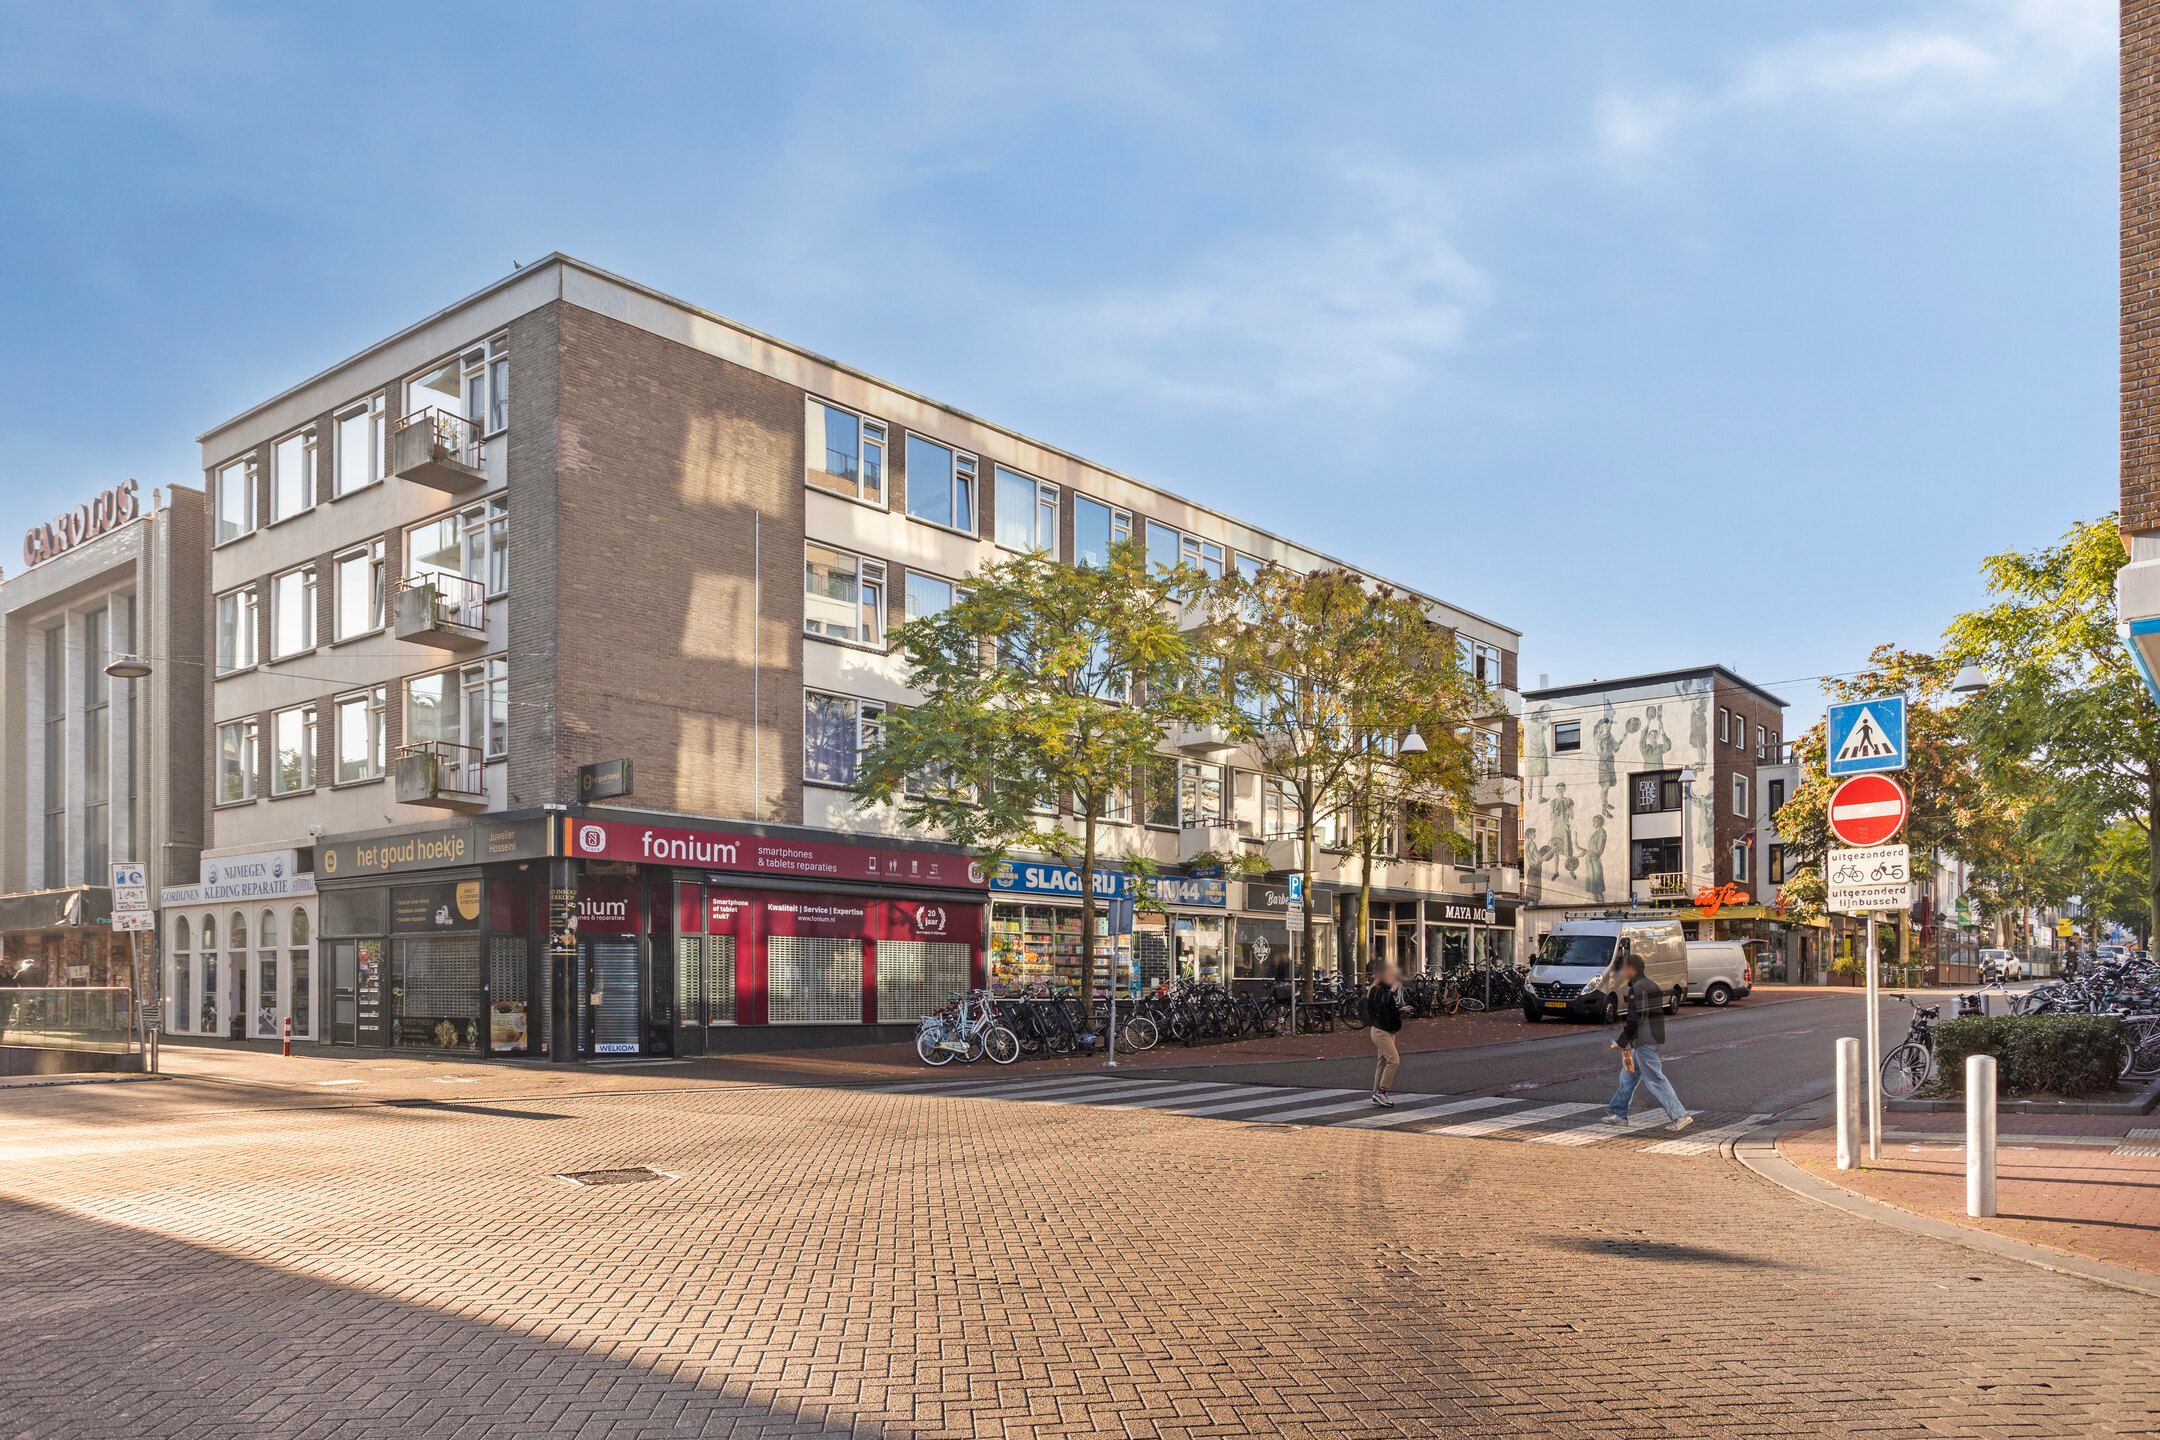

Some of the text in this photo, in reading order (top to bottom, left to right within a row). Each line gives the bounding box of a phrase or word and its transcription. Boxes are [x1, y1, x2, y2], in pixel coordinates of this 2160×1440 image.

[23, 478, 139, 567] CAROLUS
[357, 835, 465, 869] het goud hoekje
[758, 847, 813, 861] smartphones
[1832, 849, 1904, 861] uitgezonderd
[224, 863, 267, 880] NIJMEGEN
[758, 859, 837, 873] & tablets reparaties
[204, 879, 288, 900] KLEDING REPARATIE
[1123, 876, 1178, 899] PEIN
[1180, 882, 1200, 900] 44
[1832, 886, 1906, 898] uitgezonderd
[577, 897, 625, 915] nium
[712, 898, 749, 906] Smartphone
[767, 903, 864, 916] Kwaliteit Service Expertise
[927, 909, 936, 917] 20
[1445, 905, 1471, 919] MAYA
[797, 915, 836, 923] www.fonium.nl
[925, 917, 938, 926] jaar
